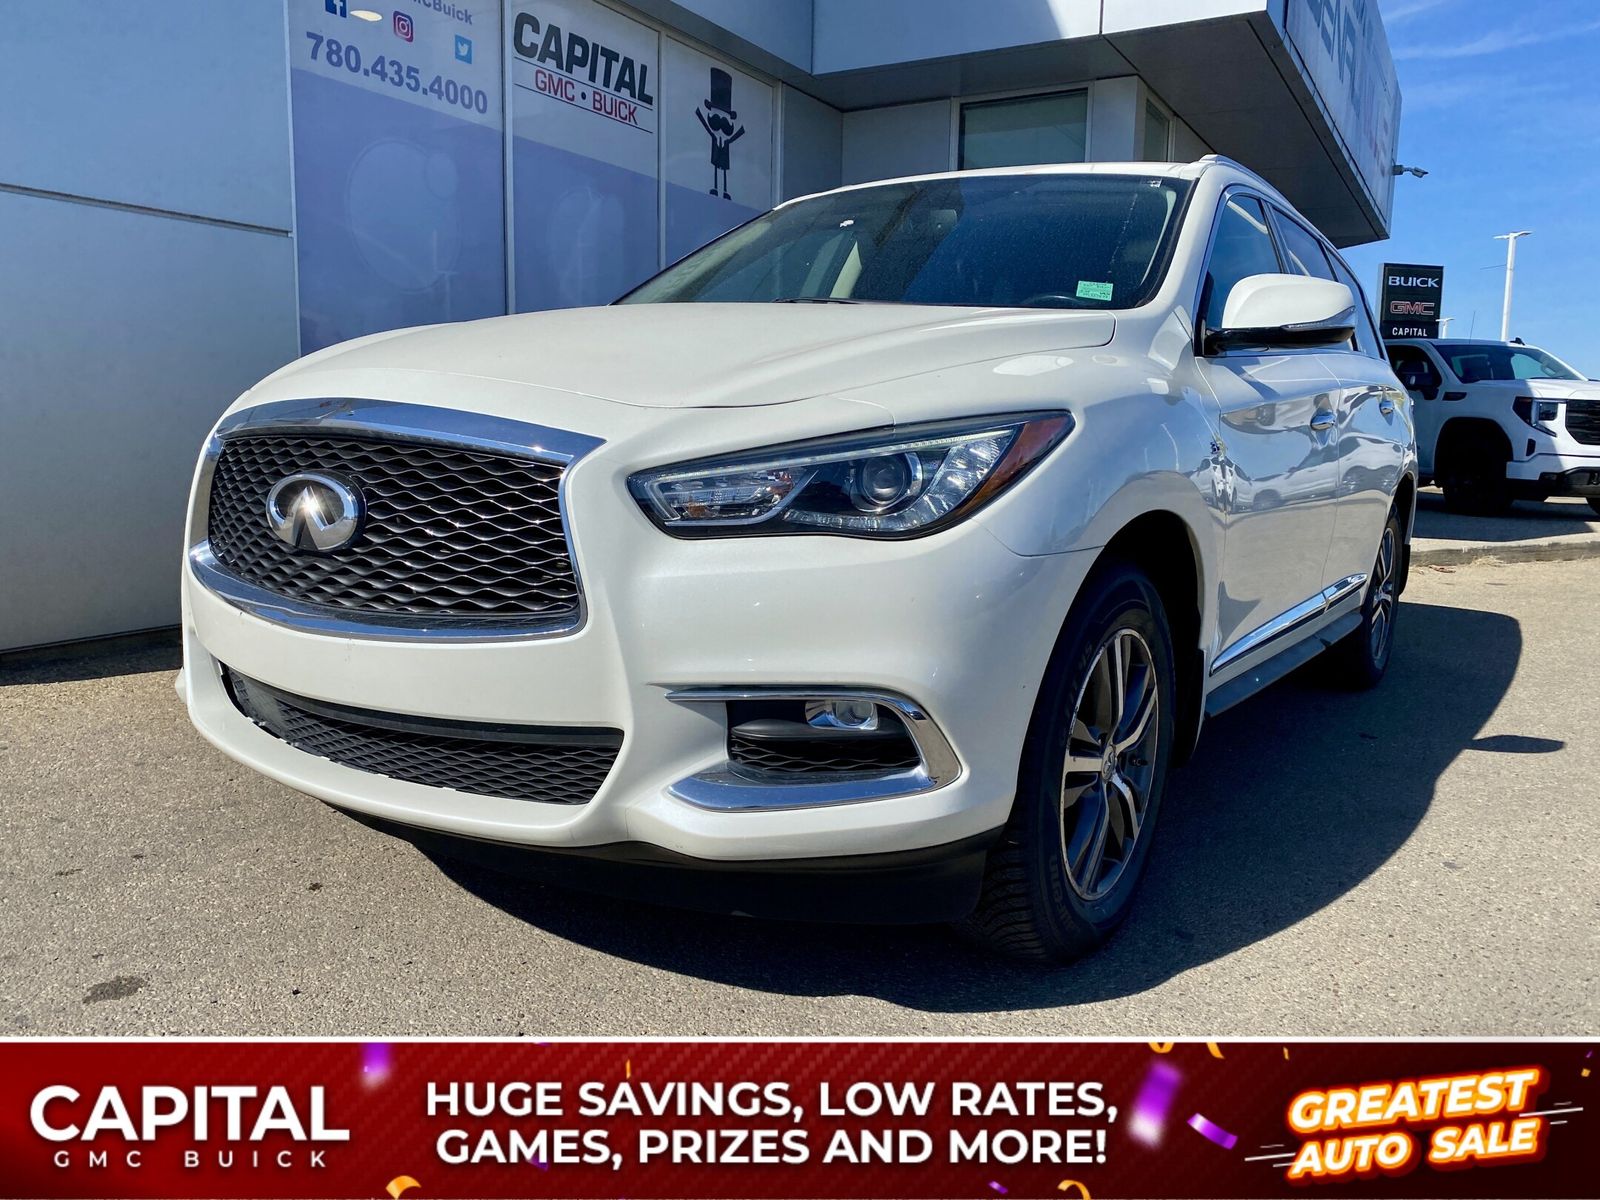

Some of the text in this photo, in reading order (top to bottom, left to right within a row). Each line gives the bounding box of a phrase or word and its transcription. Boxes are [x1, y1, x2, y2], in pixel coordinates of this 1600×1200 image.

[306, 31, 488, 114] 780.435.4000
[513, 12, 654, 106] CAPITAL
[535, 69, 638, 125] GMC BUICK
[1388, 275, 1440, 288] BUICK
[1390, 300, 1435, 316] GMC
[1392, 327, 1428, 337] CAPITAL
